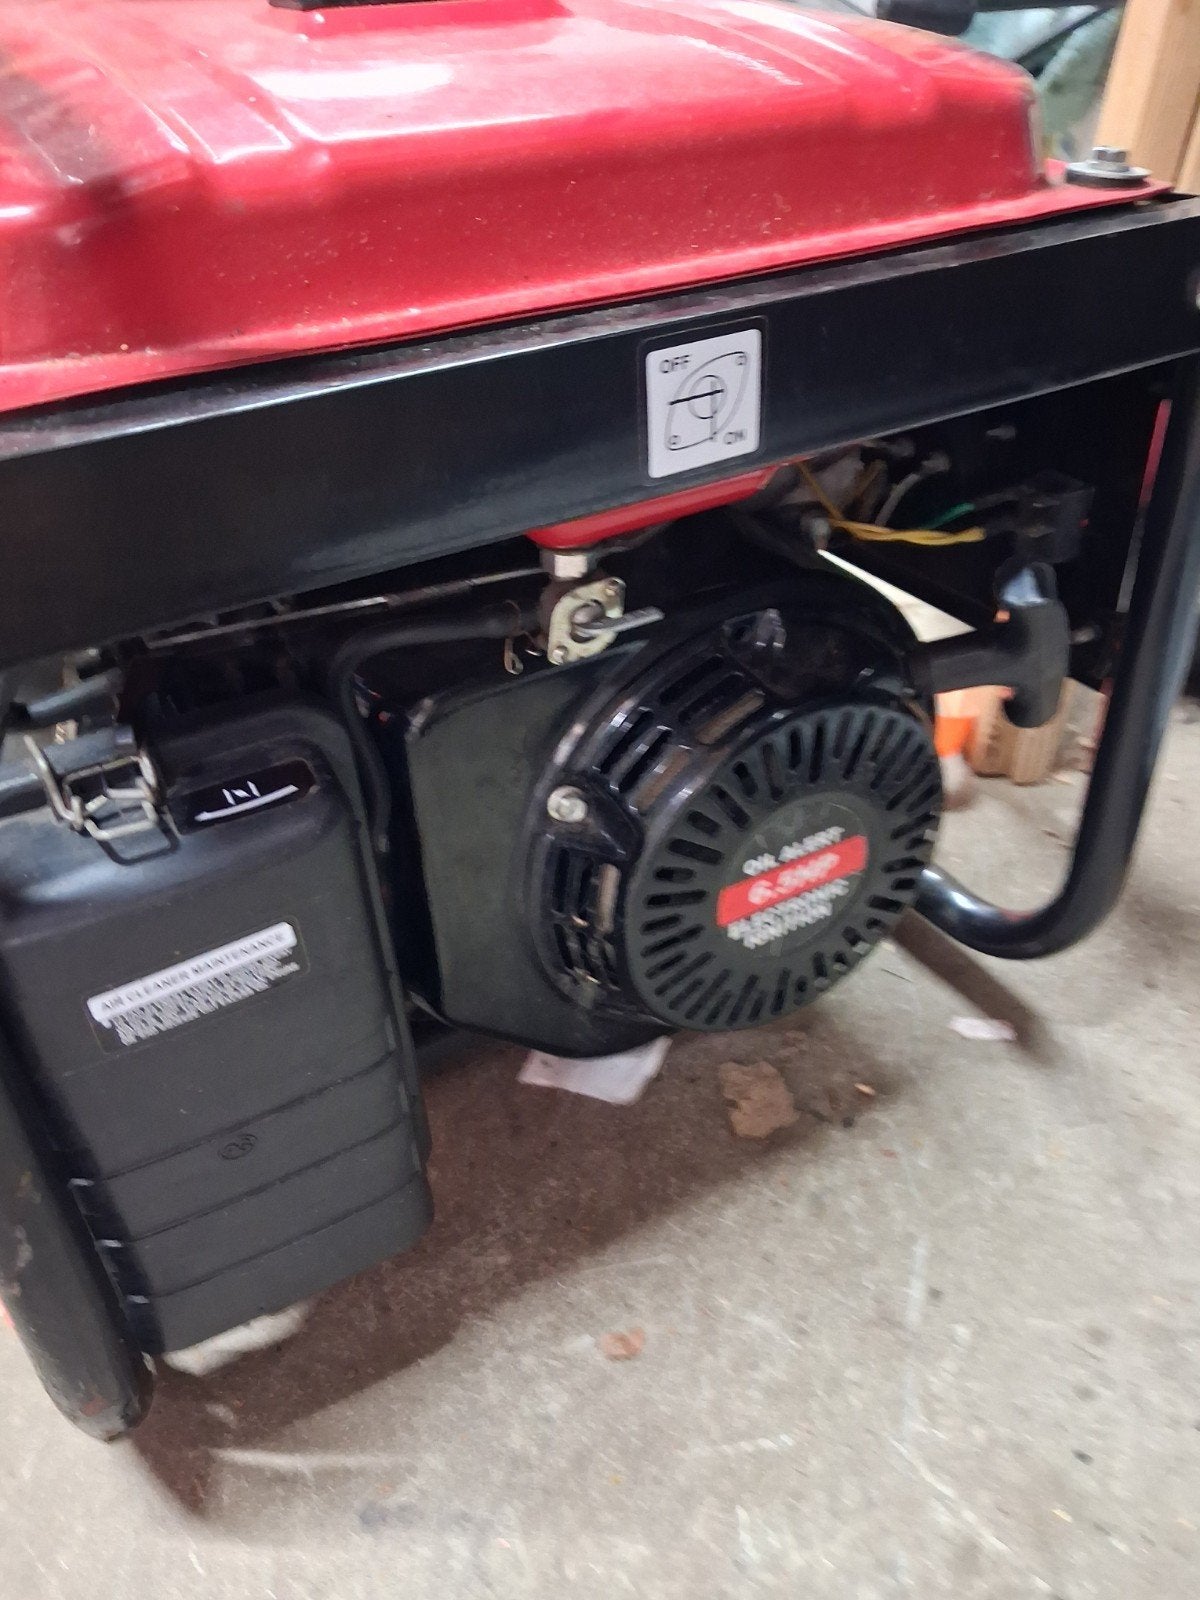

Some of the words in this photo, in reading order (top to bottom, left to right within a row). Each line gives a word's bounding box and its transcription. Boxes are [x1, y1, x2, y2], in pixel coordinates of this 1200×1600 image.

[659, 354, 690, 374] OFF
[723, 429, 747, 445] ON
[126, 970, 190, 1002] CLEANER
[190, 930, 284, 974] MAINTENANCE
